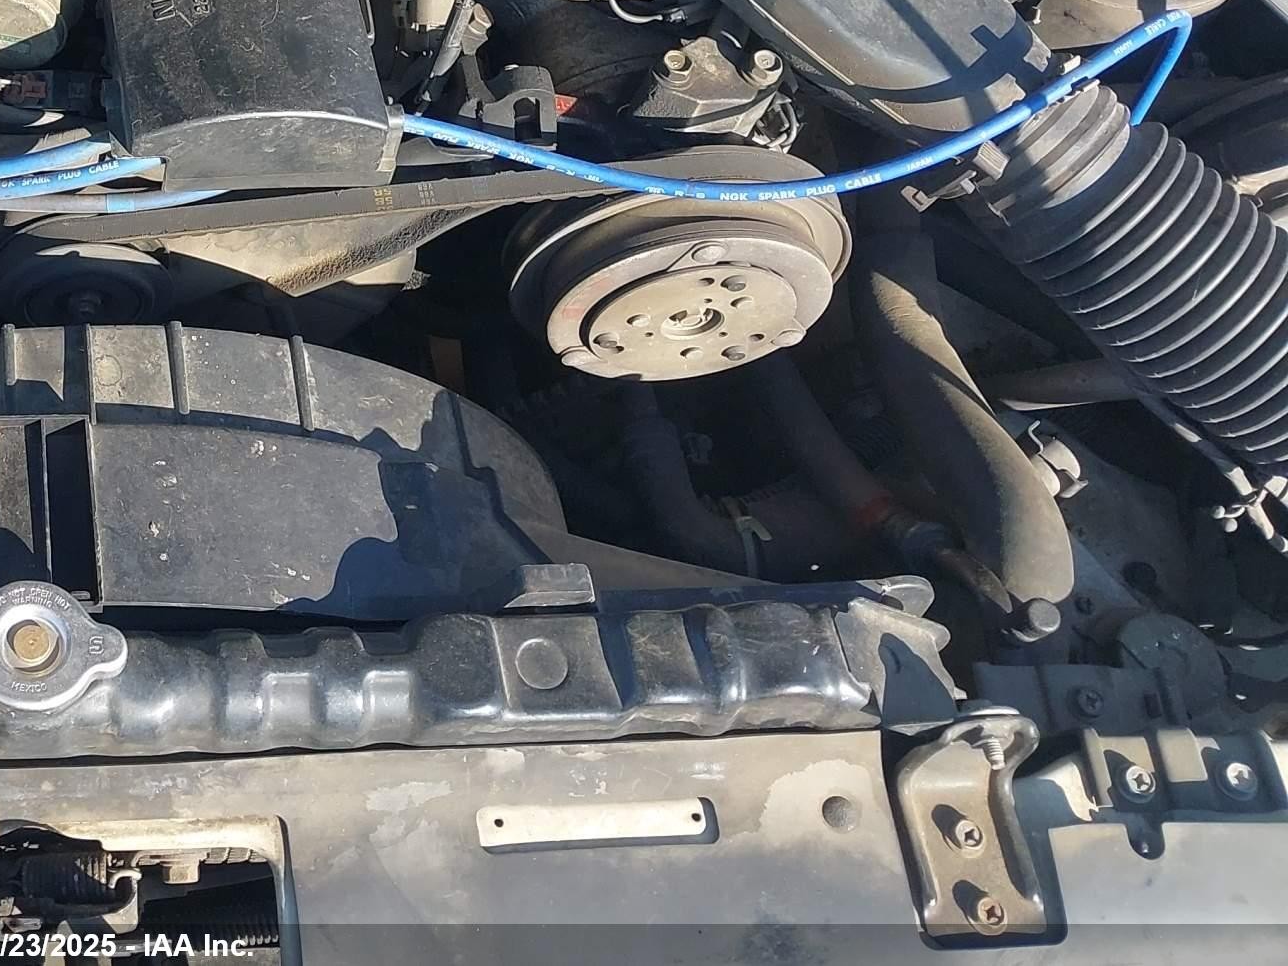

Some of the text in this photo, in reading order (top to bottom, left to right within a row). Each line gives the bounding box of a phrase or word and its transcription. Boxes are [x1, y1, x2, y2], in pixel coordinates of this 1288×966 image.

[509, 152, 535, 165] NGK
[21, 174, 51, 186] SPARK
[58, 170, 82, 181] PLUG
[88, 160, 120, 175] CABLE
[719, 190, 749, 201] NGK
[758, 188, 797, 201] SPARK
[806, 184, 836, 198] PLUG
[844, 173, 883, 190] CABLE
[9, 587, 26, 598] NOT
[30, 587, 53, 600] OPEN
[54, 593, 72, 611] HOT
[11, 597, 54, 609] WARNING
[88, 636, 105, 656] S
[11, 681, 48, 693] MEXICO
